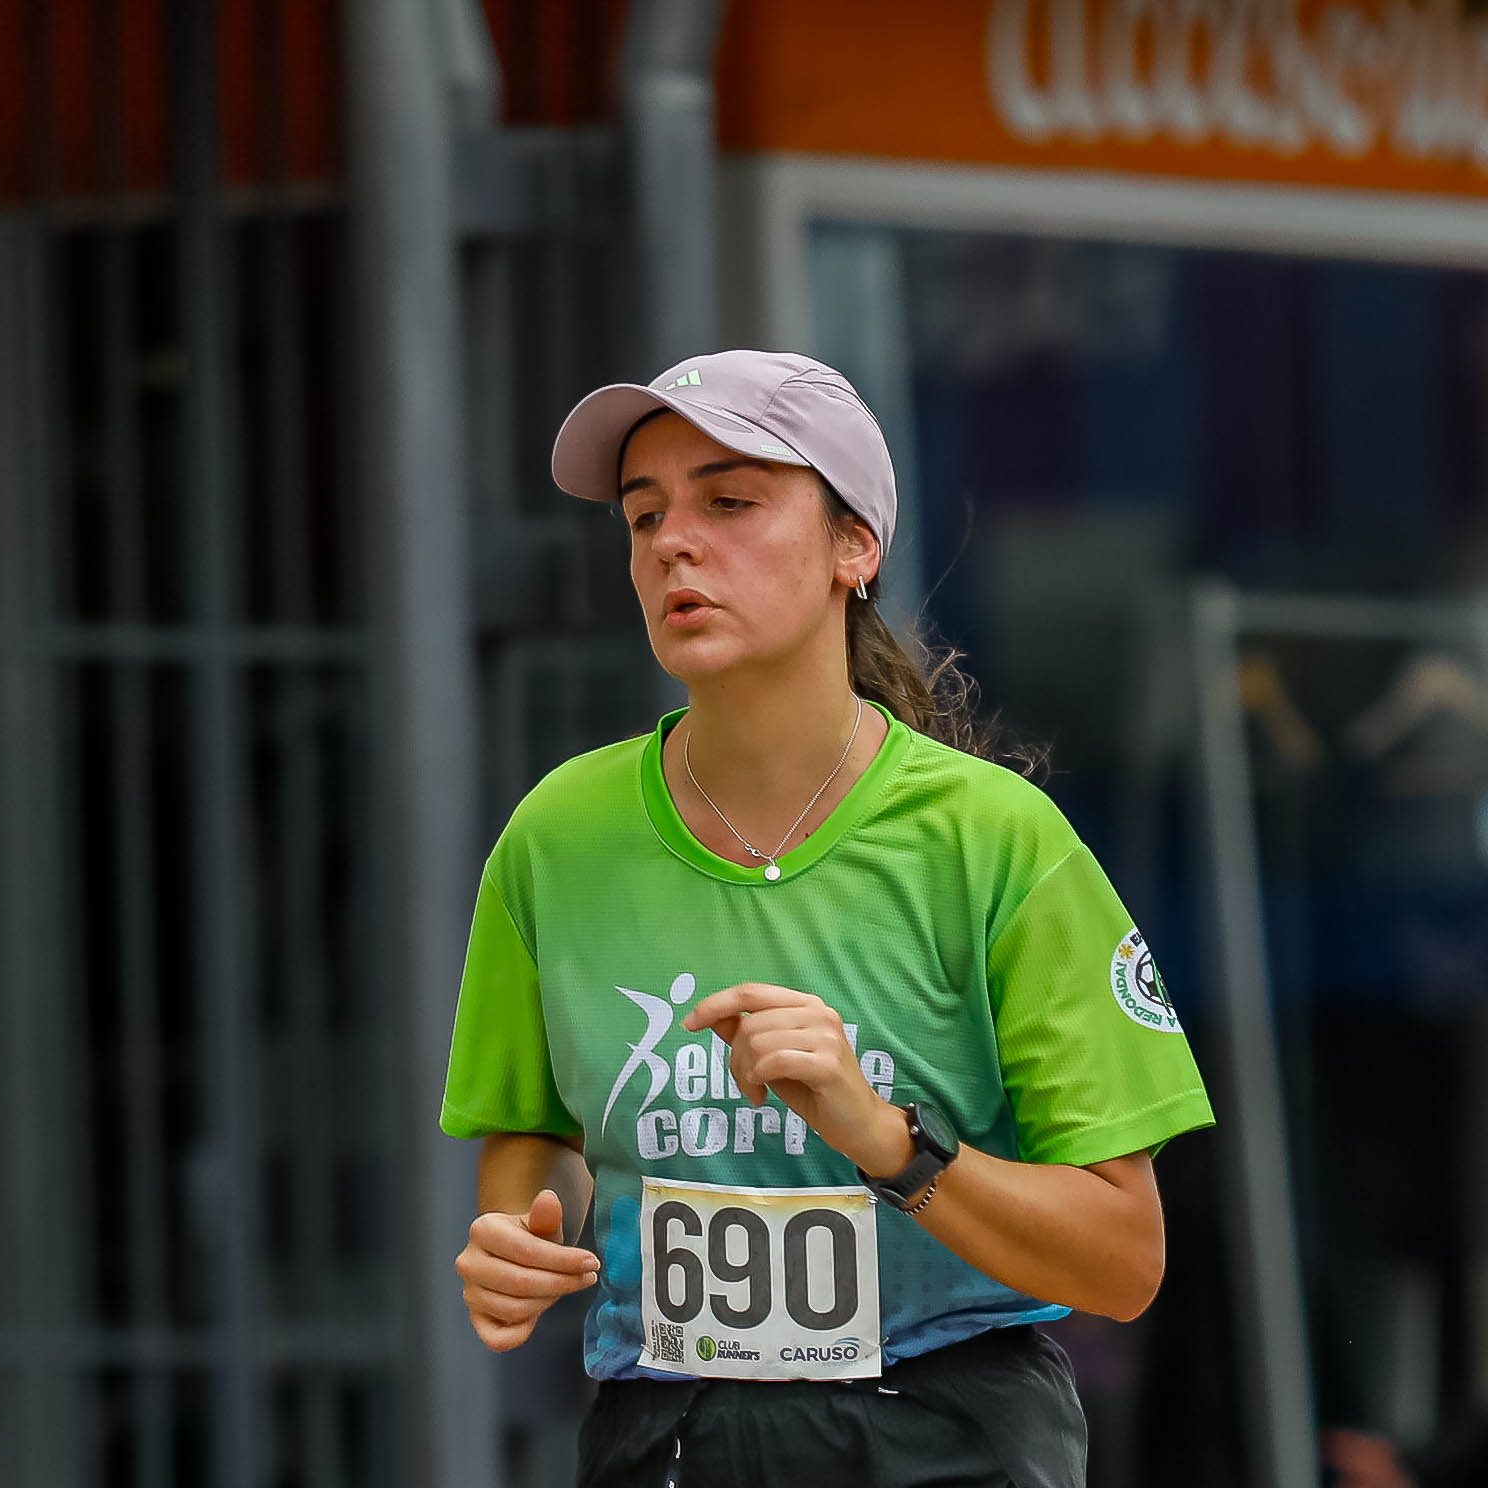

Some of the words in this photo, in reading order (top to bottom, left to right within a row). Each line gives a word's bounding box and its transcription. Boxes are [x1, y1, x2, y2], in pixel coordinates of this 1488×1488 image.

[653, 1200, 859, 1331] 690
[717, 1340, 741, 1350] CLUB
[780, 1346, 859, 1362] CARUSO
